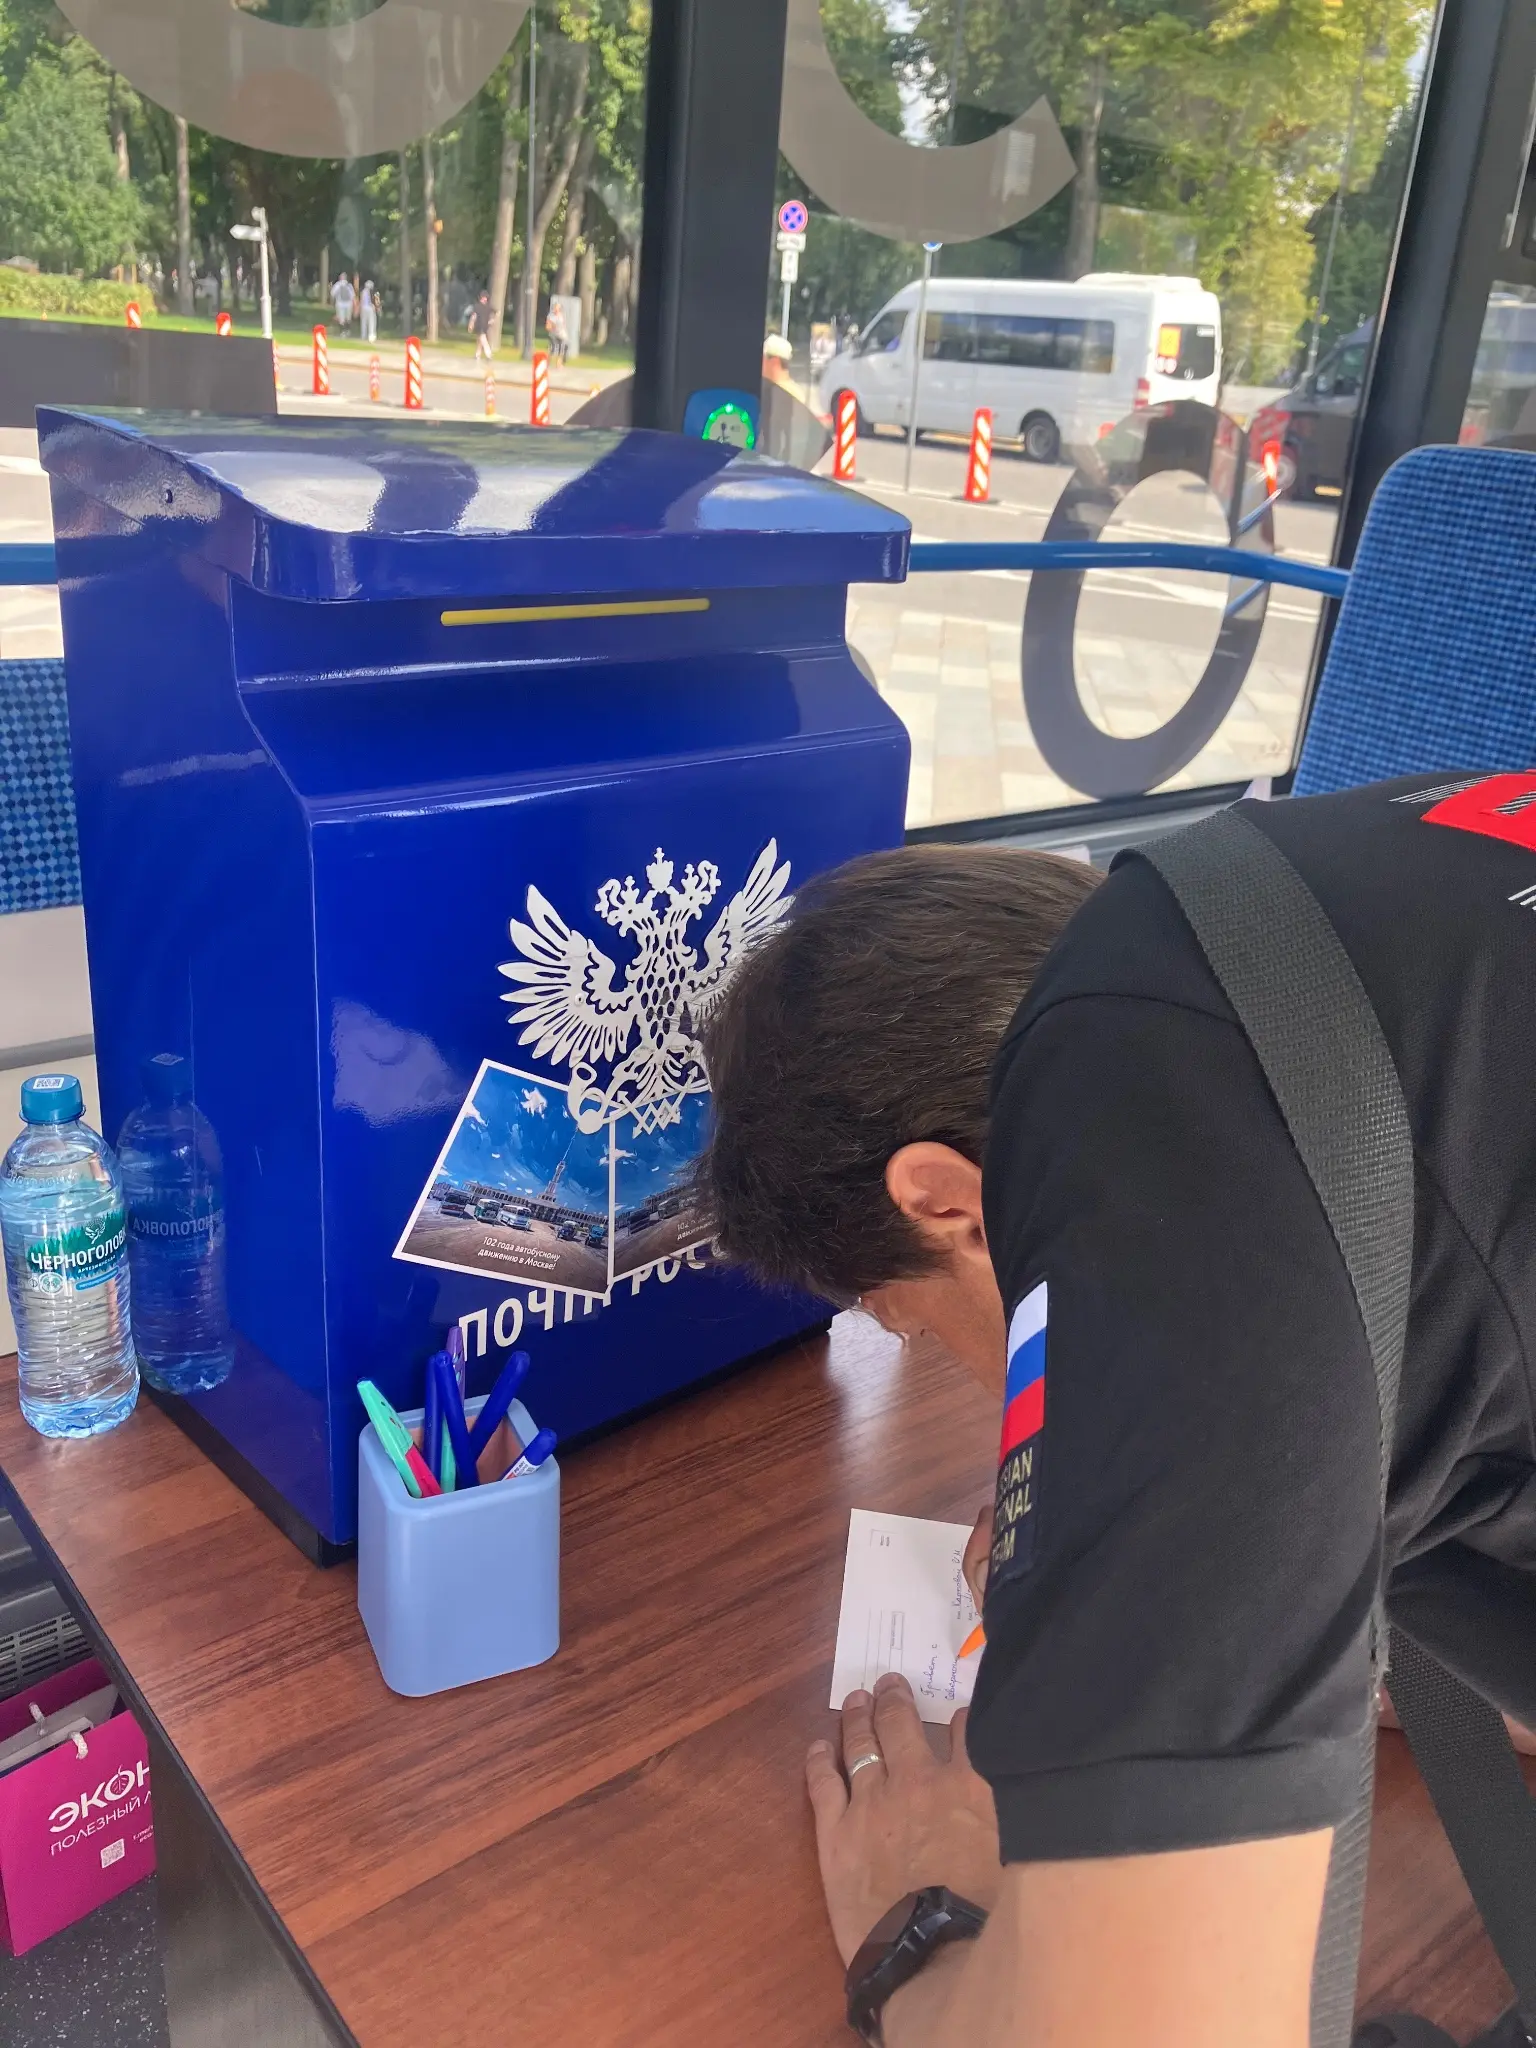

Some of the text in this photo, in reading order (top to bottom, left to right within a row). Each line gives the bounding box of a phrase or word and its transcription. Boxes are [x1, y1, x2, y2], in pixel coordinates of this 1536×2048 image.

[478, 1249, 518, 1263] движению
[524, 1256, 557, 1270] Москве!
[483, 1236, 561, 1262] 102 года автобусному
[51, 1796, 141, 1856] ПОЛЕЗНЫЙ
